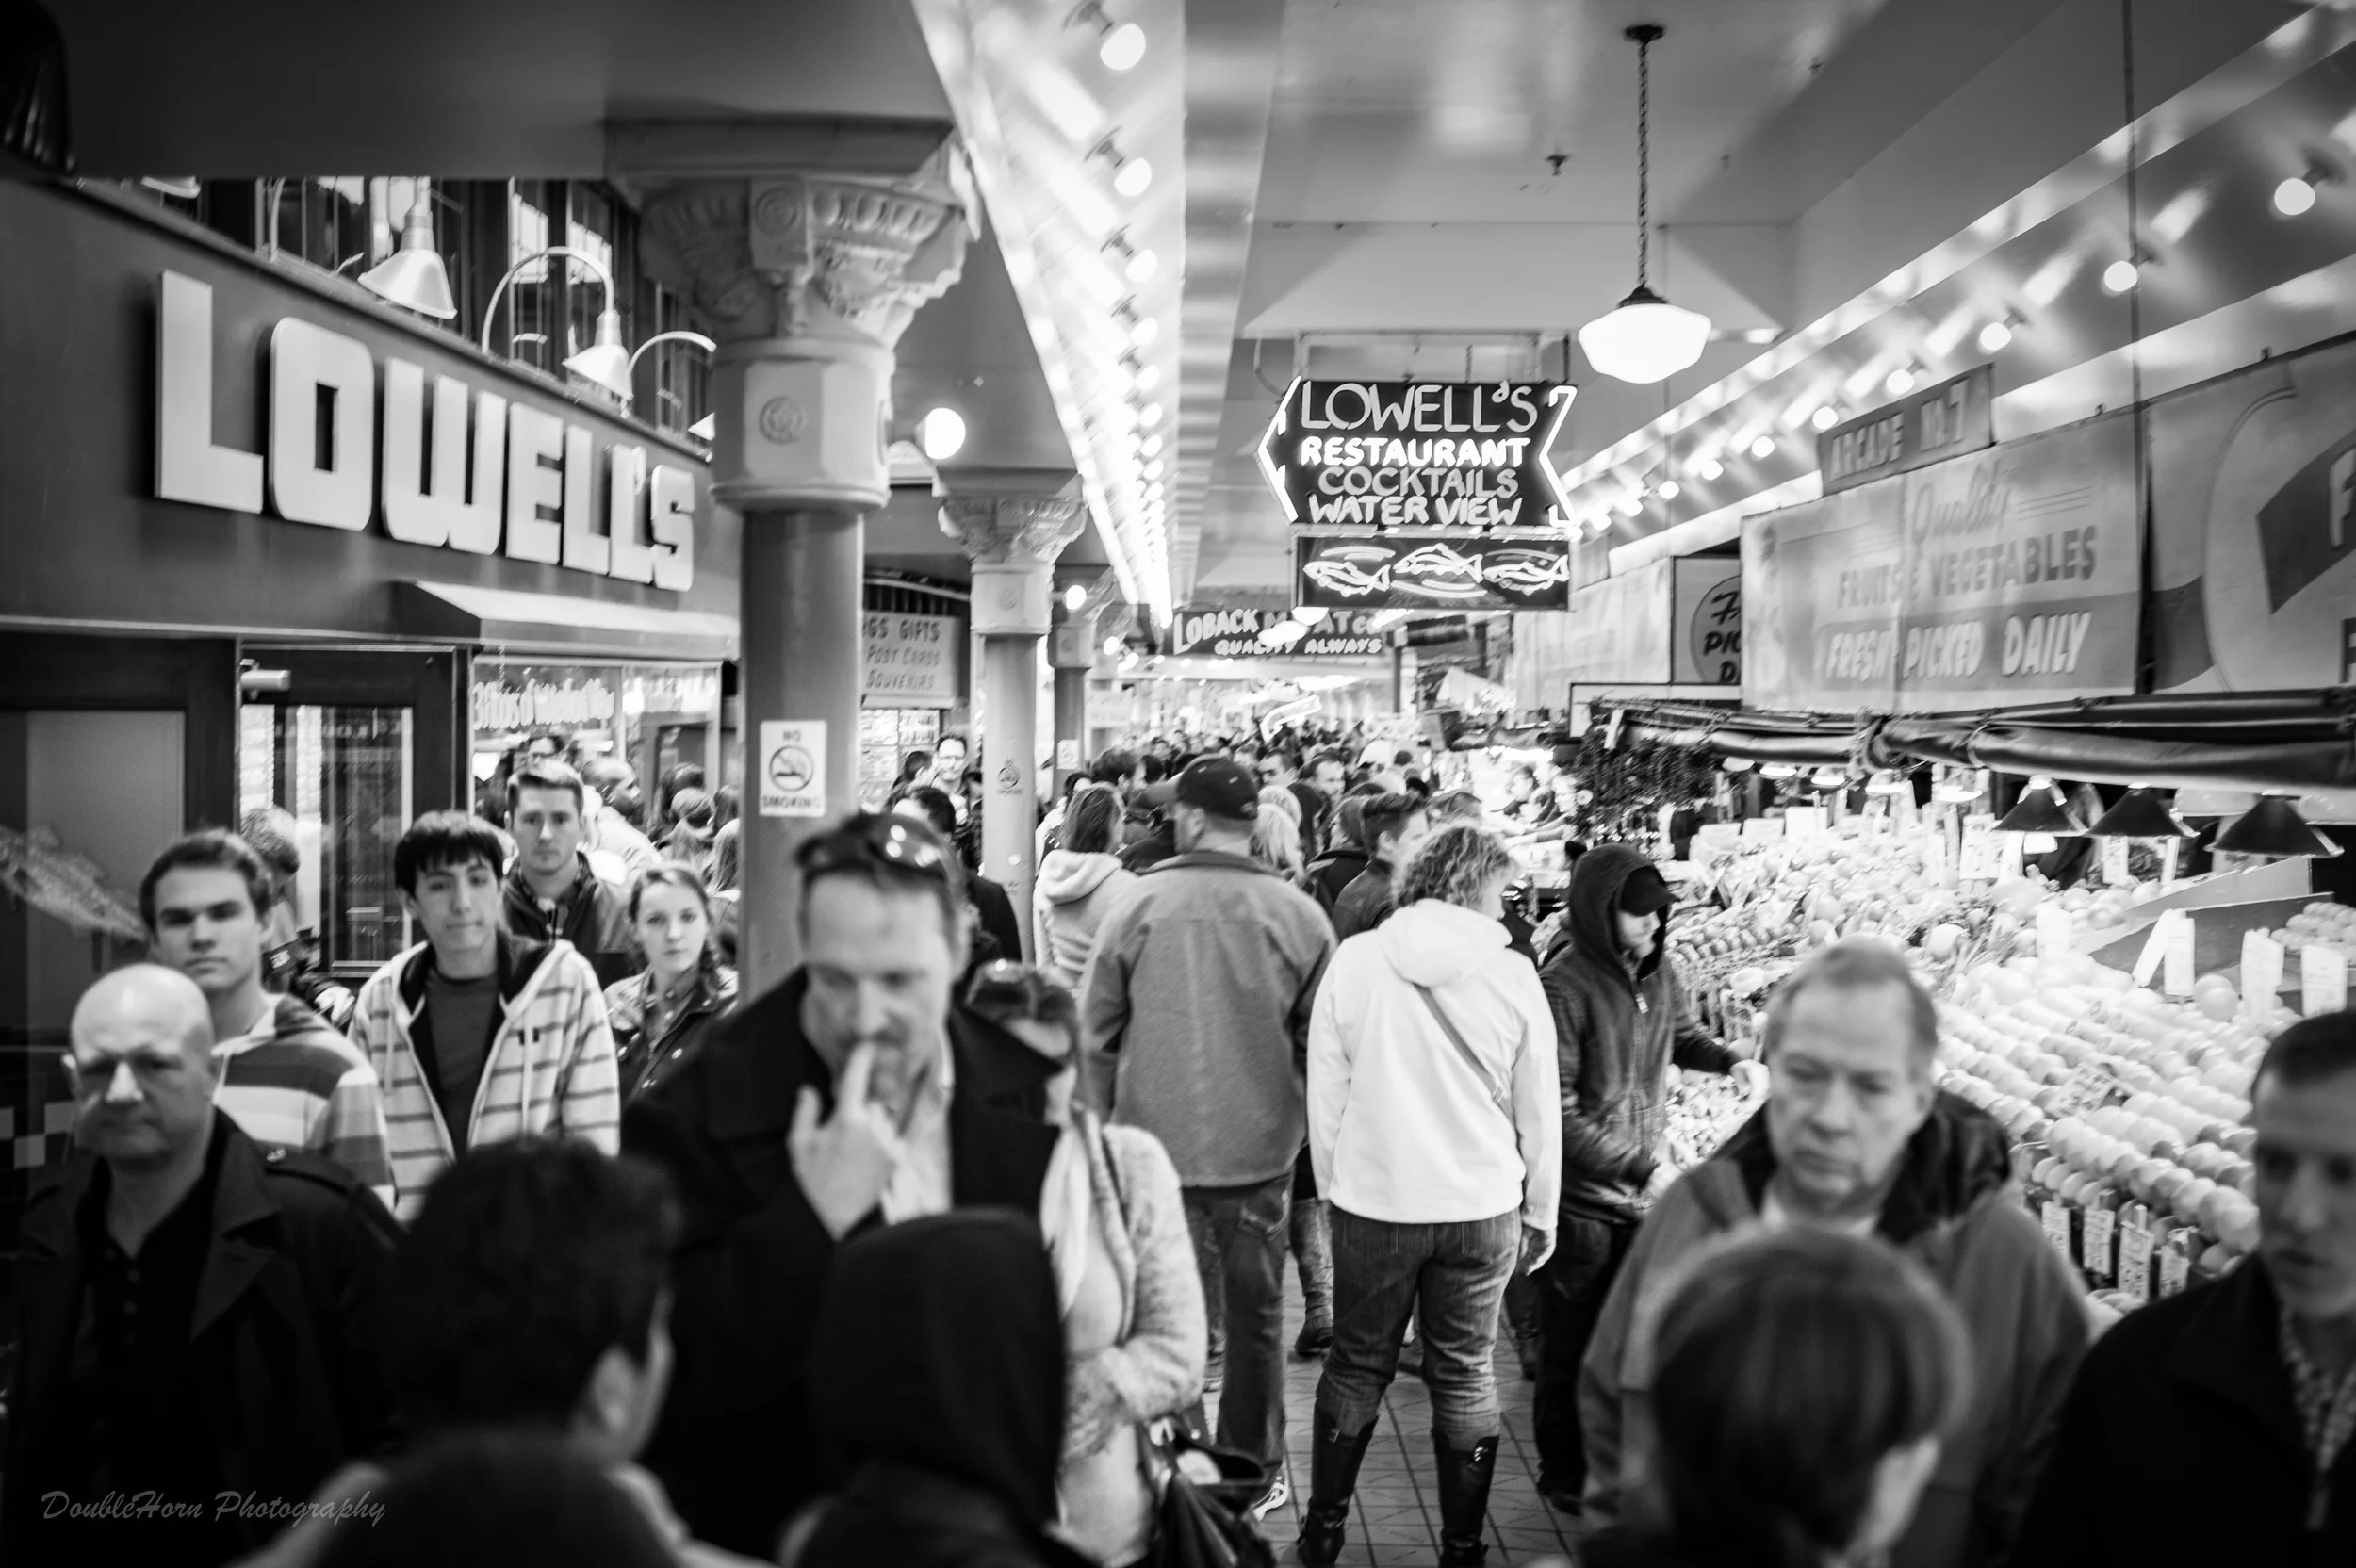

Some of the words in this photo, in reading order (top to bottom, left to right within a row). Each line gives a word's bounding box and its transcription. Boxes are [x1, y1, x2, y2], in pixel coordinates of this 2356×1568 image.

[1301, 380, 1538, 433] LOWELL'S
[155, 269, 695, 592] LOWELL'S
[1301, 436, 1531, 468] RESTAURANT
[1829, 412, 1904, 482] ARCADE
[1318, 466, 1519, 498] COCKTAILS
[1308, 495, 1429, 525] WATER
[1434, 496, 1523, 526] VIEW
[1929, 524, 2098, 598] VEGETABLES
[899, 618, 941, 643] GIFTS
[1263, 610, 1353, 635] MAT
[1303, 638, 1383, 655] ALWAYS
[1824, 629, 1894, 681] FRESH
[1902, 618, 1984, 679] PICKED
[2002, 612, 2093, 678] DAILY
[782, 729, 801, 743] NO
[761, 795, 822, 809] SMOKING
